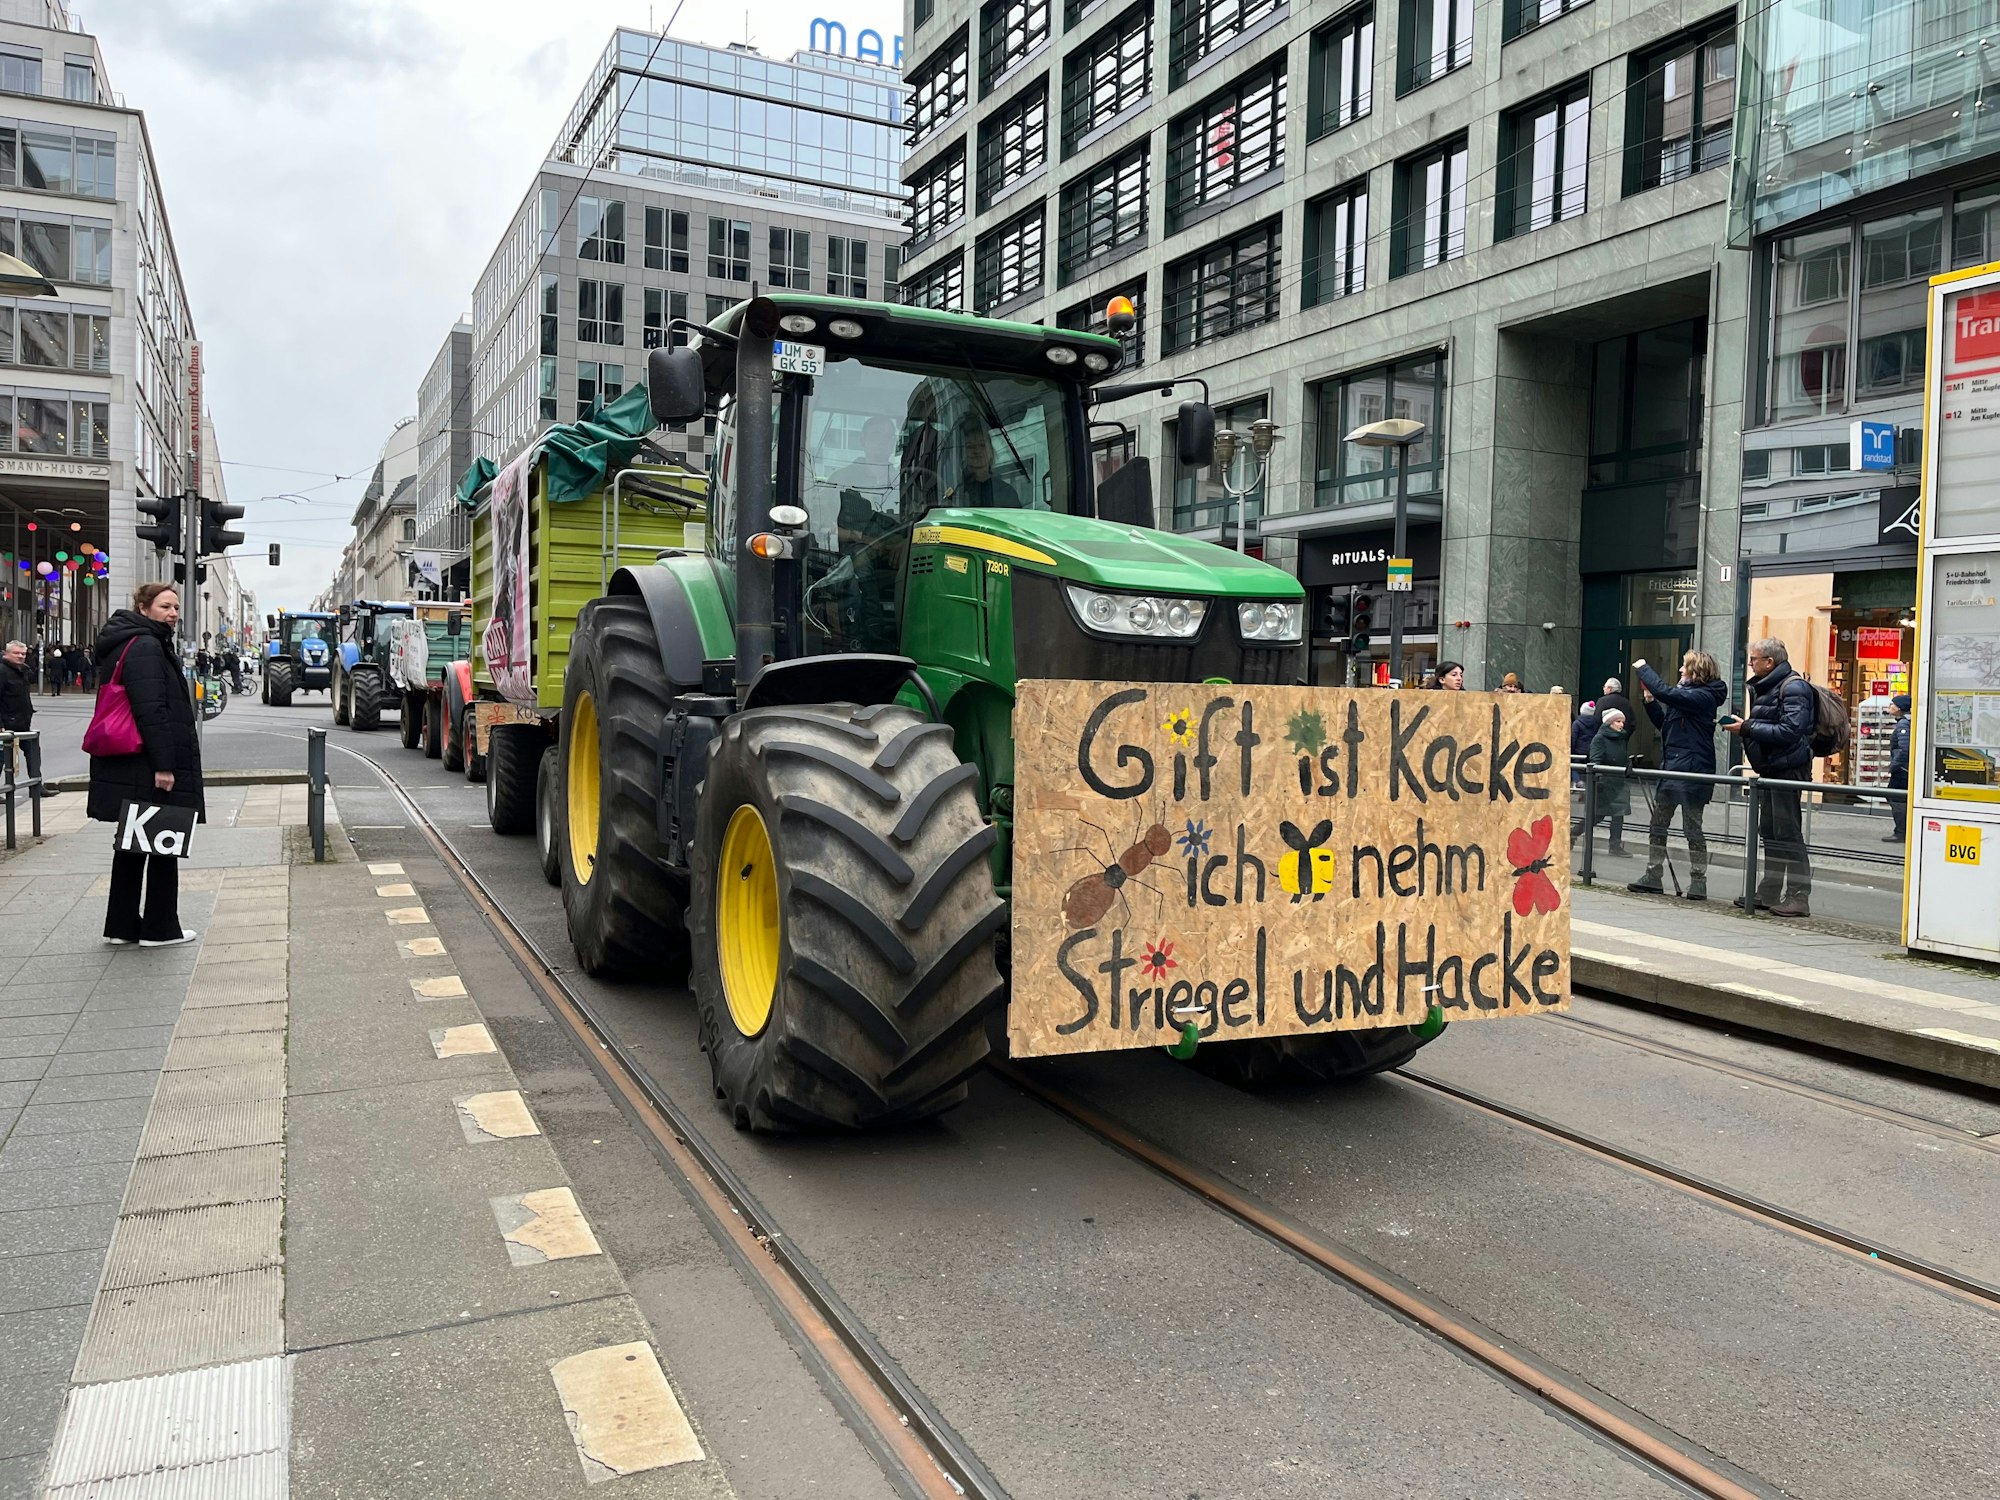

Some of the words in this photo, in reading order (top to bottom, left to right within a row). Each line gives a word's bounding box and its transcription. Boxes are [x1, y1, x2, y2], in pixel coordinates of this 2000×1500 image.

[784, 344, 802, 358] UM
[780, 357, 797, 371] GK
[801, 360, 817, 374] 55
[1952, 382, 1964, 391] M1
[1953, 410, 1962, 419] 12
[1864, 453, 1891, 463] randstad
[1946, 578, 1991, 586] Friedrichstraße
[1078, 688, 1261, 801] Gift
[1298, 699, 1365, 798] ist
[1390, 699, 1553, 803] Kacke
[1949, 843, 1976, 860] BVG
[1187, 823, 1265, 908] ich
[1352, 817, 1486, 899] nehm
[1055, 925, 1267, 1038] Striegel
[1294, 920, 1385, 1026] und
[1397, 911, 1561, 1015] Hacke
